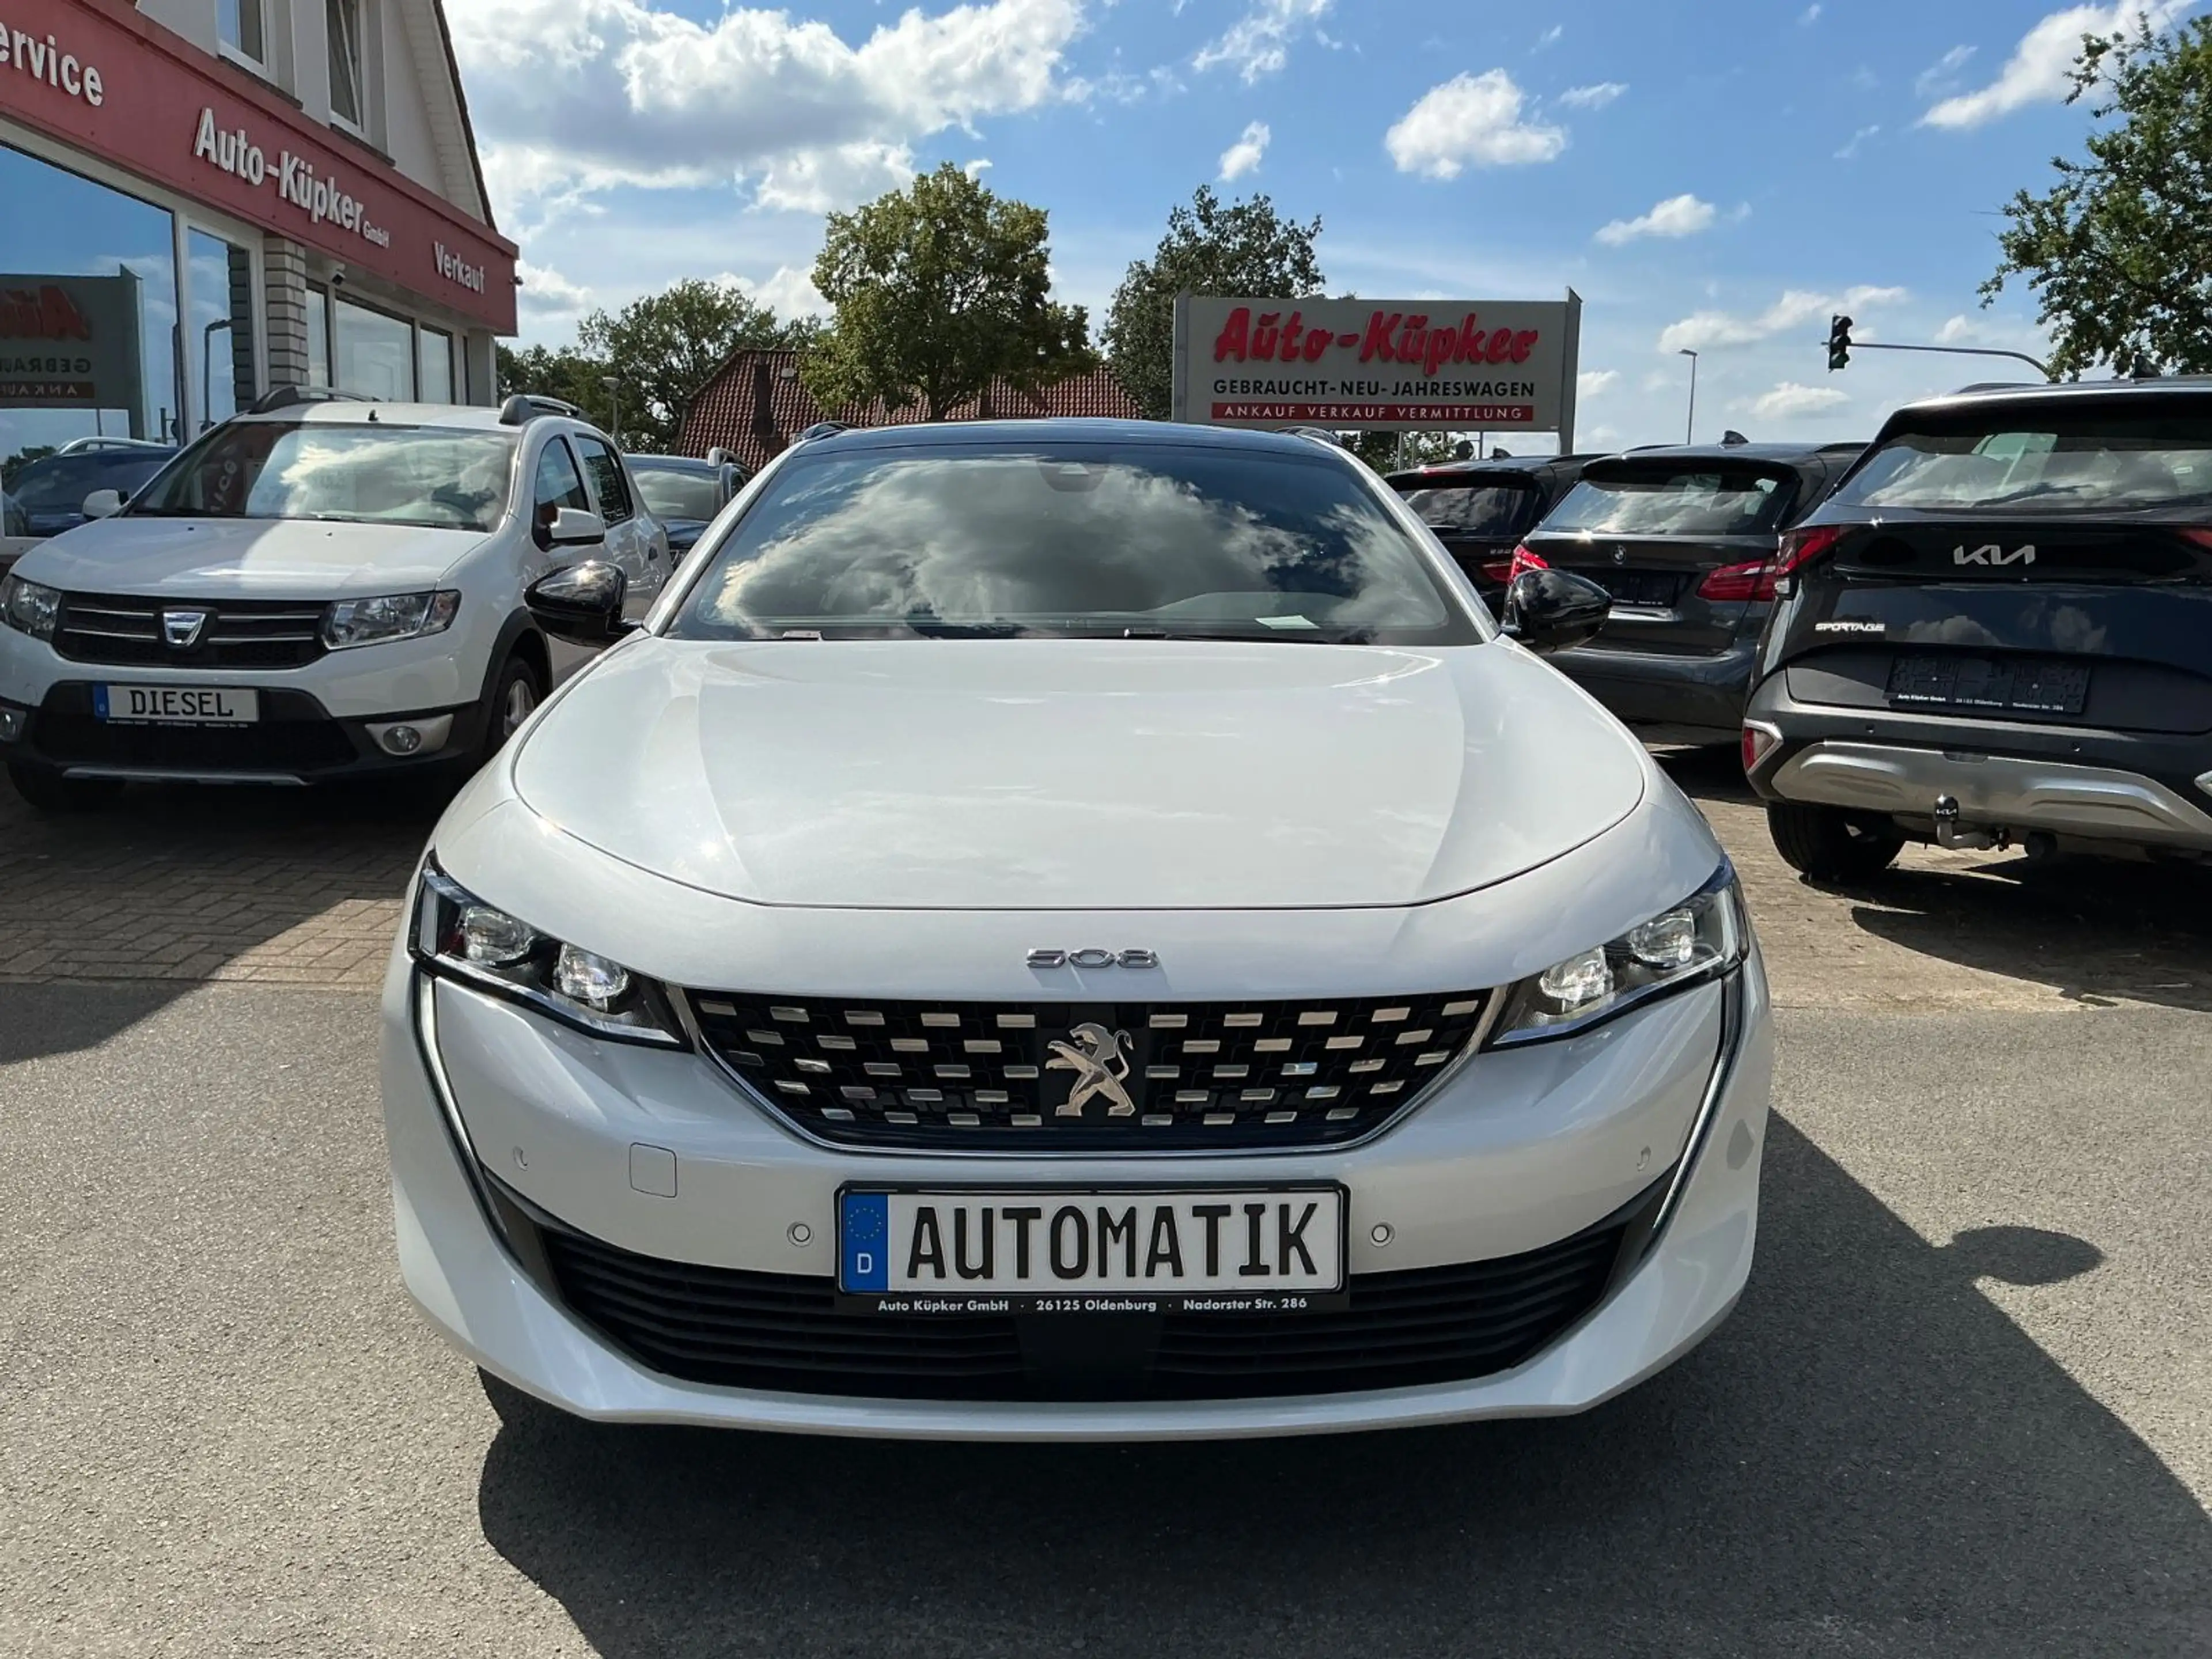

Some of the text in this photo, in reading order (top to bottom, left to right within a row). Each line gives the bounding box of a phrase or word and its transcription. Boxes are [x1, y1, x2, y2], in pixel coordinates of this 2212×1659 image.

[194, 107, 364, 233] Auto-Küpker
[434, 241, 484, 294] Verkauf
[1225, 406, 1522, 419] ANKAUF VERKAUF VERMITTLUNG
[1815, 622, 1885, 632] SPORTAGE
[129, 690, 234, 717] DIESEL
[1026, 948, 1158, 968] 508
[907, 1203, 1319, 1279] AUTOMATIK
[857, 1253, 872, 1274] D
[878, 1297, 1308, 1313] Auto Küpker GmbH 26125 Oldenburg Nadorster Str. 286
